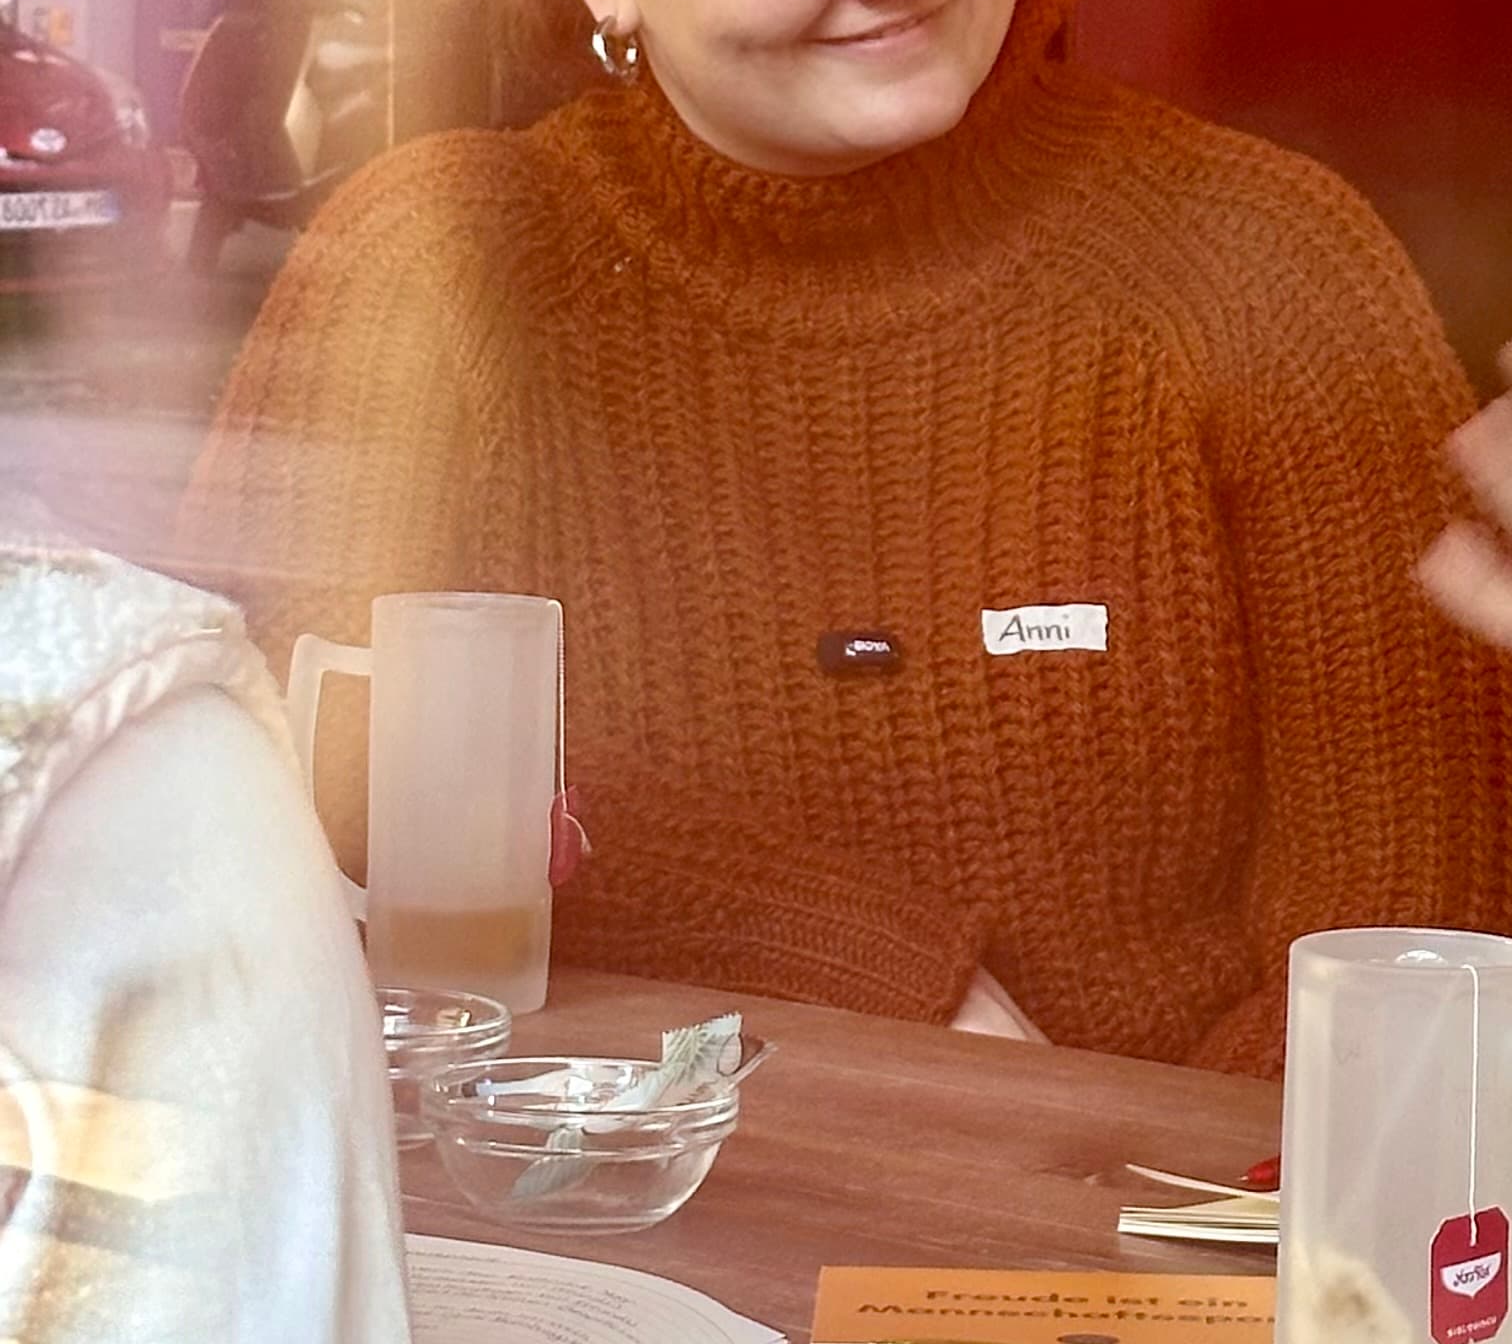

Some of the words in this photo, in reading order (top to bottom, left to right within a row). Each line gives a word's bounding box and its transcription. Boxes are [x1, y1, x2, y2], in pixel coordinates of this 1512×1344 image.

[999, 613, 1071, 643] Anni
[926, 1289, 1089, 1305] Freude
[1106, 1294, 1160, 1306] ist
[1178, 1296, 1249, 1308] ein
